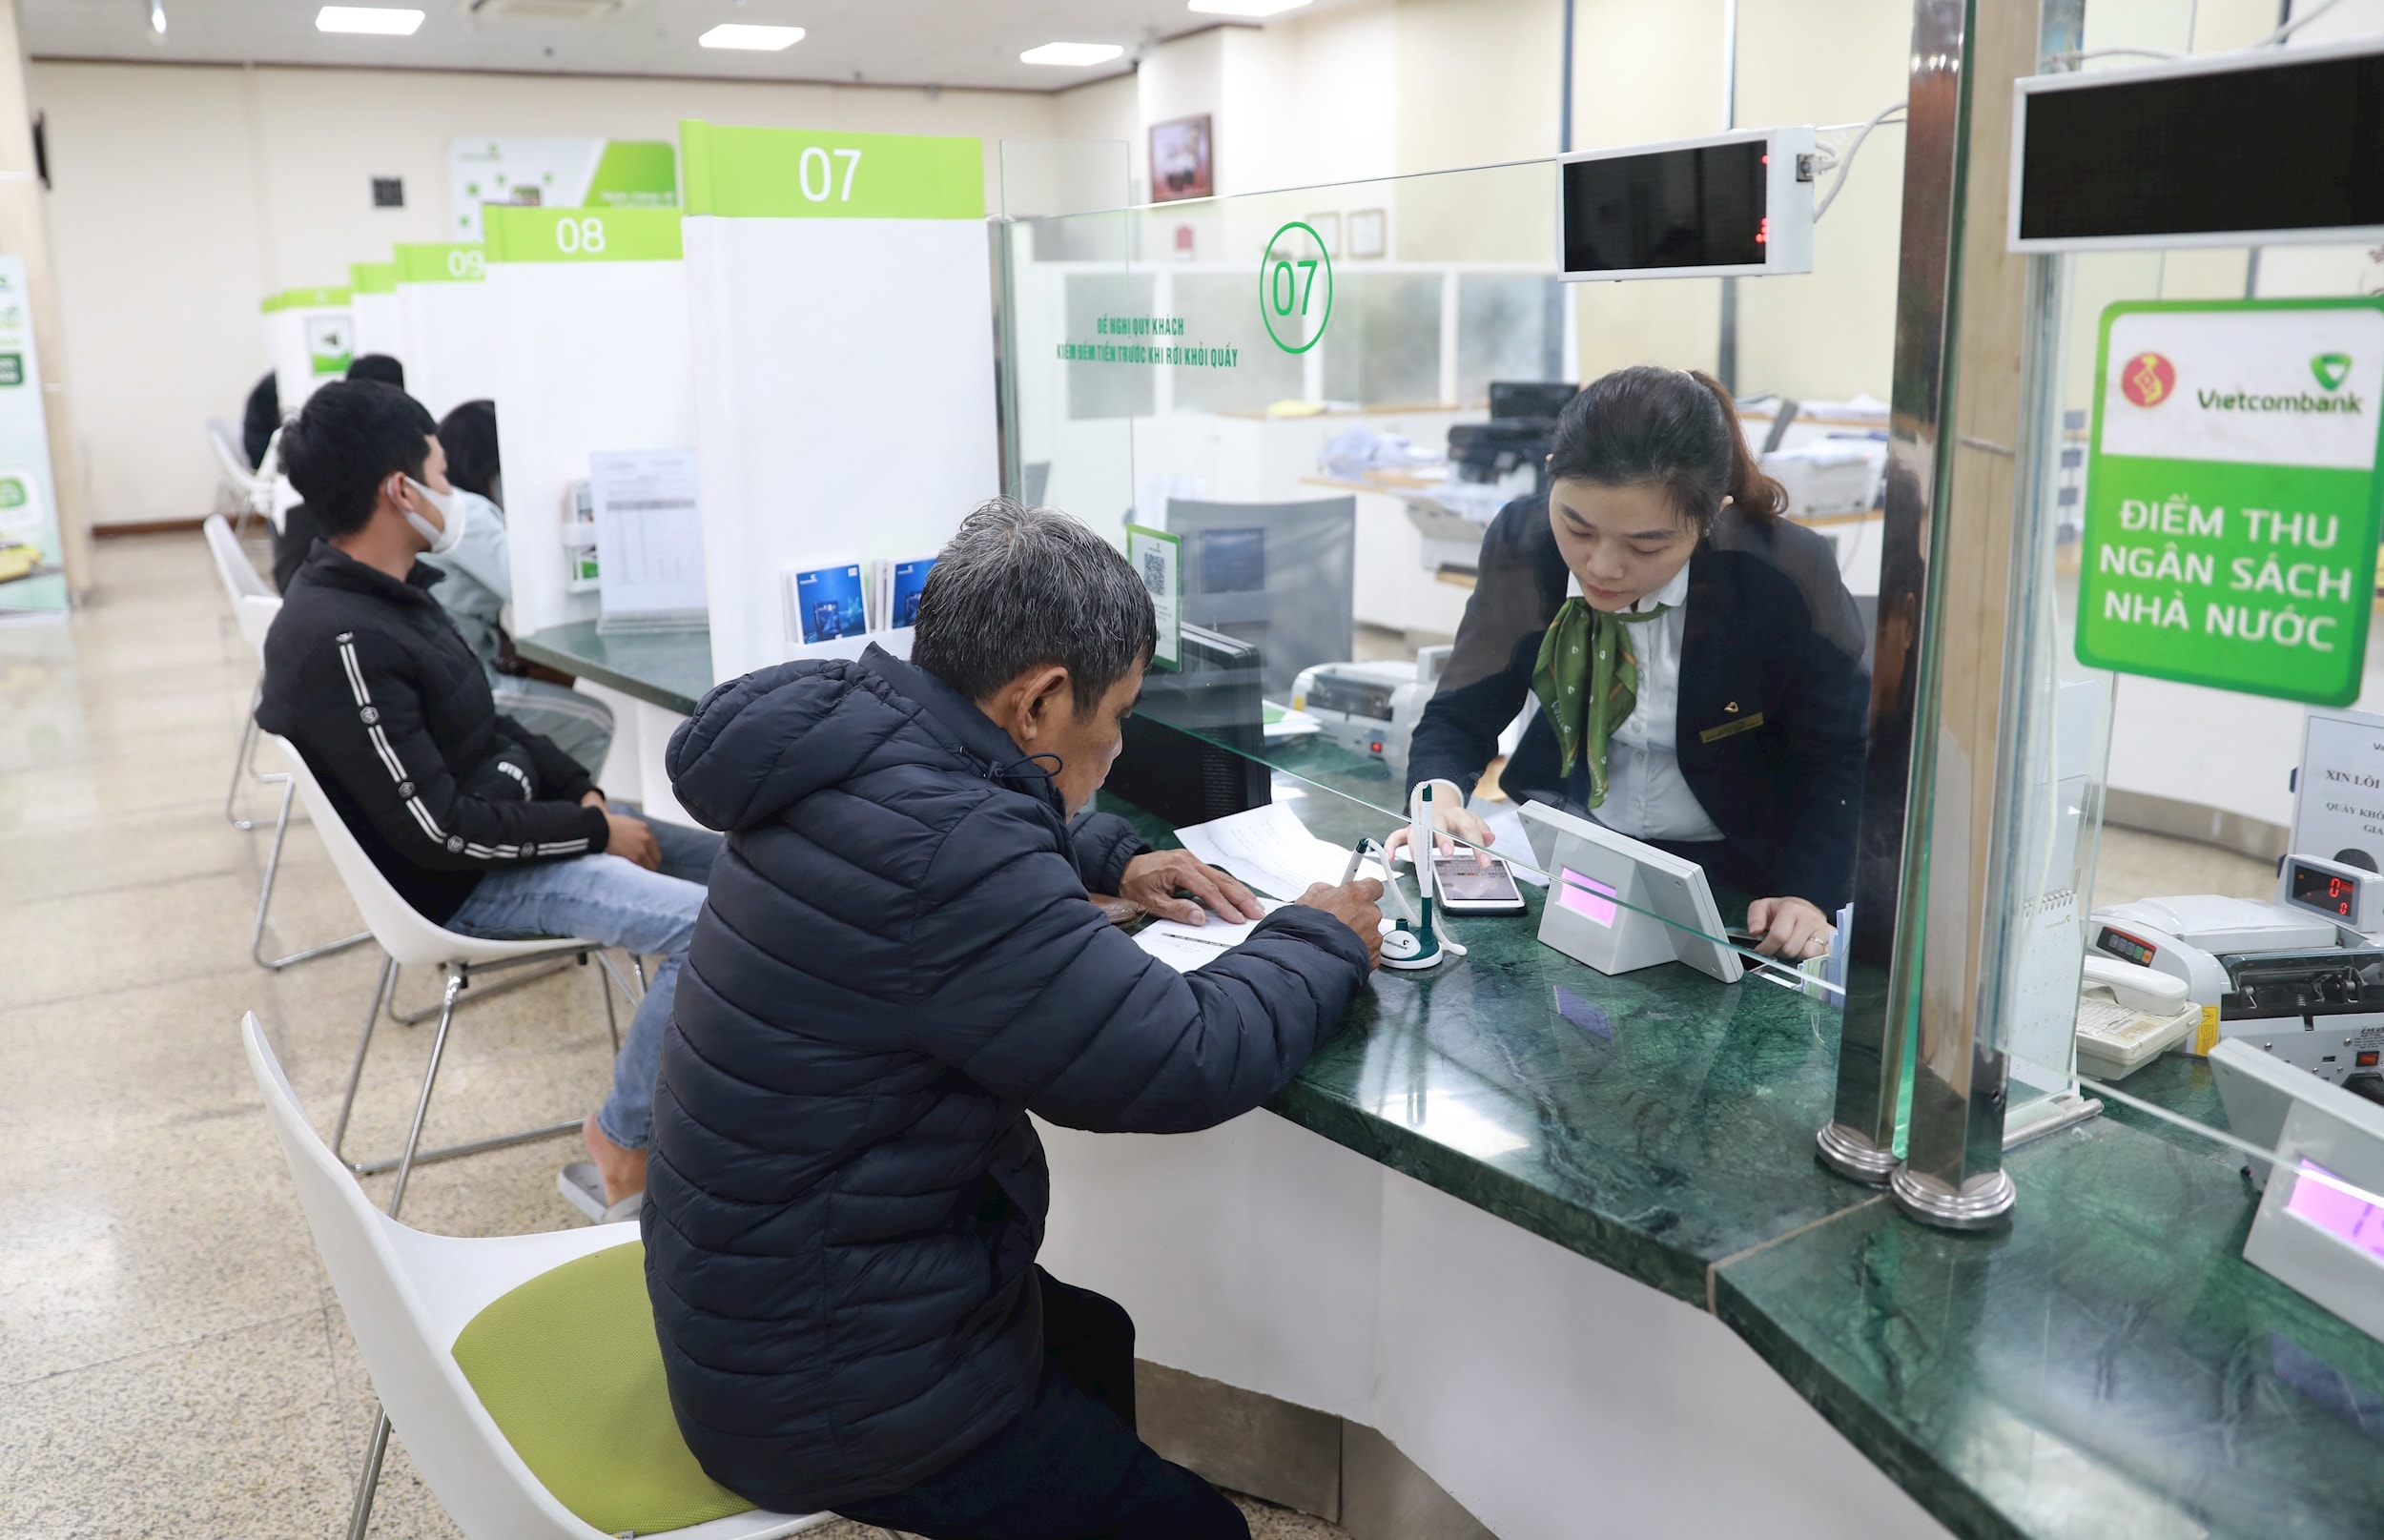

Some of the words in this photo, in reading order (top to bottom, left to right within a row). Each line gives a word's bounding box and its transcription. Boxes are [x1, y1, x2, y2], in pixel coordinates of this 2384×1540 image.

[799, 147, 862, 202] 07
[556, 217, 606, 253] 08
[448, 250, 484, 277] 09
[1273, 260, 1318, 316] 07
[1133, 314, 1150, 335] QUÝ
[1152, 314, 1184, 336] KHÁCH
[1148, 347, 1163, 365] KHI
[1166, 342, 1182, 365] RỜI
[1184, 341, 1208, 366] KHỎI
[2198, 389, 2362, 414] Vietcombank
[2120, 493, 2225, 539] ĐIỂM
[2241, 508, 2339, 549] THU
[2100, 542, 2214, 585] NGÂN
[2230, 552, 2352, 603] SÁCH
[2104, 589, 2189, 630] NHÀ
[2205, 603, 2336, 651] NƯỚC
[2326, 770, 2351, 783] XIN
[2329, 877, 2341, 898] 0
